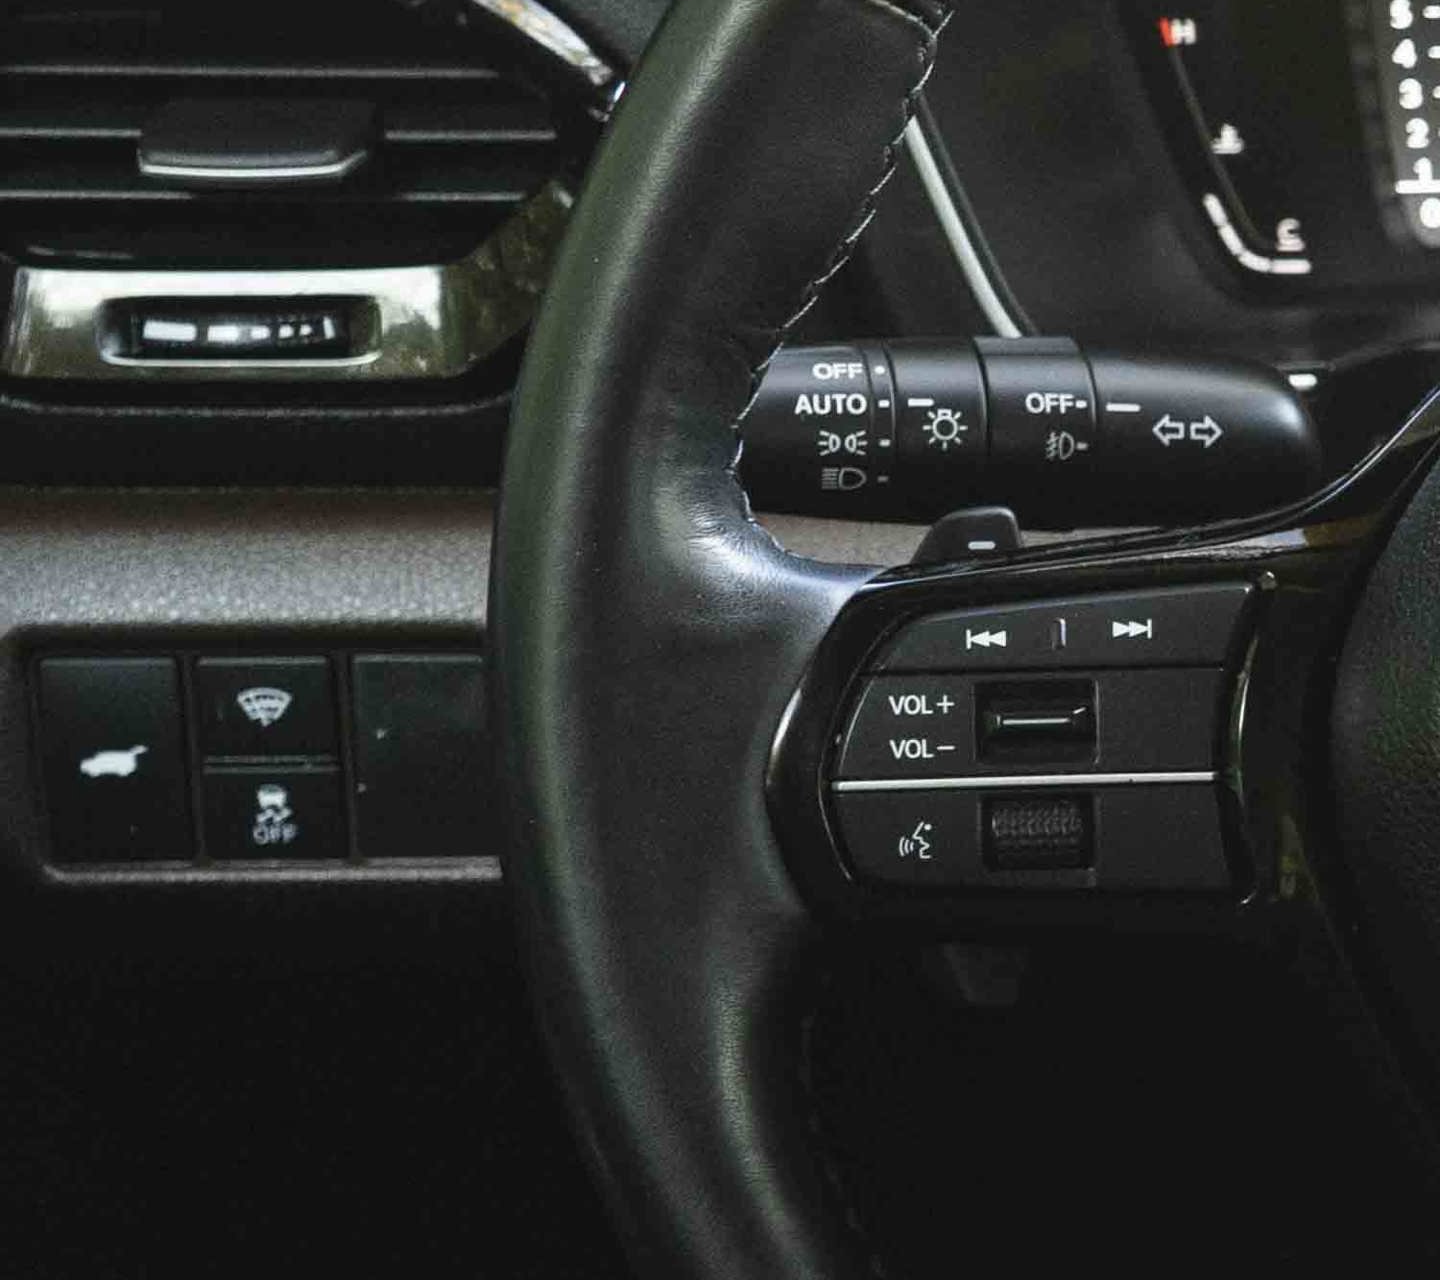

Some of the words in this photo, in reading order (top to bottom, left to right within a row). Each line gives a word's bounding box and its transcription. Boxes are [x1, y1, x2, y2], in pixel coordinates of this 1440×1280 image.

[1392, 38, 1417, 68] 4
[1399, 78, 1423, 109] 3
[1406, 118, 1430, 148] 2
[1414, 157, 1433, 181] 1
[812, 362, 863, 379] OFF
[794, 393, 867, 415] AUTO
[1025, 393, 1074, 415] OFF
[252, 822, 299, 845] OFF
